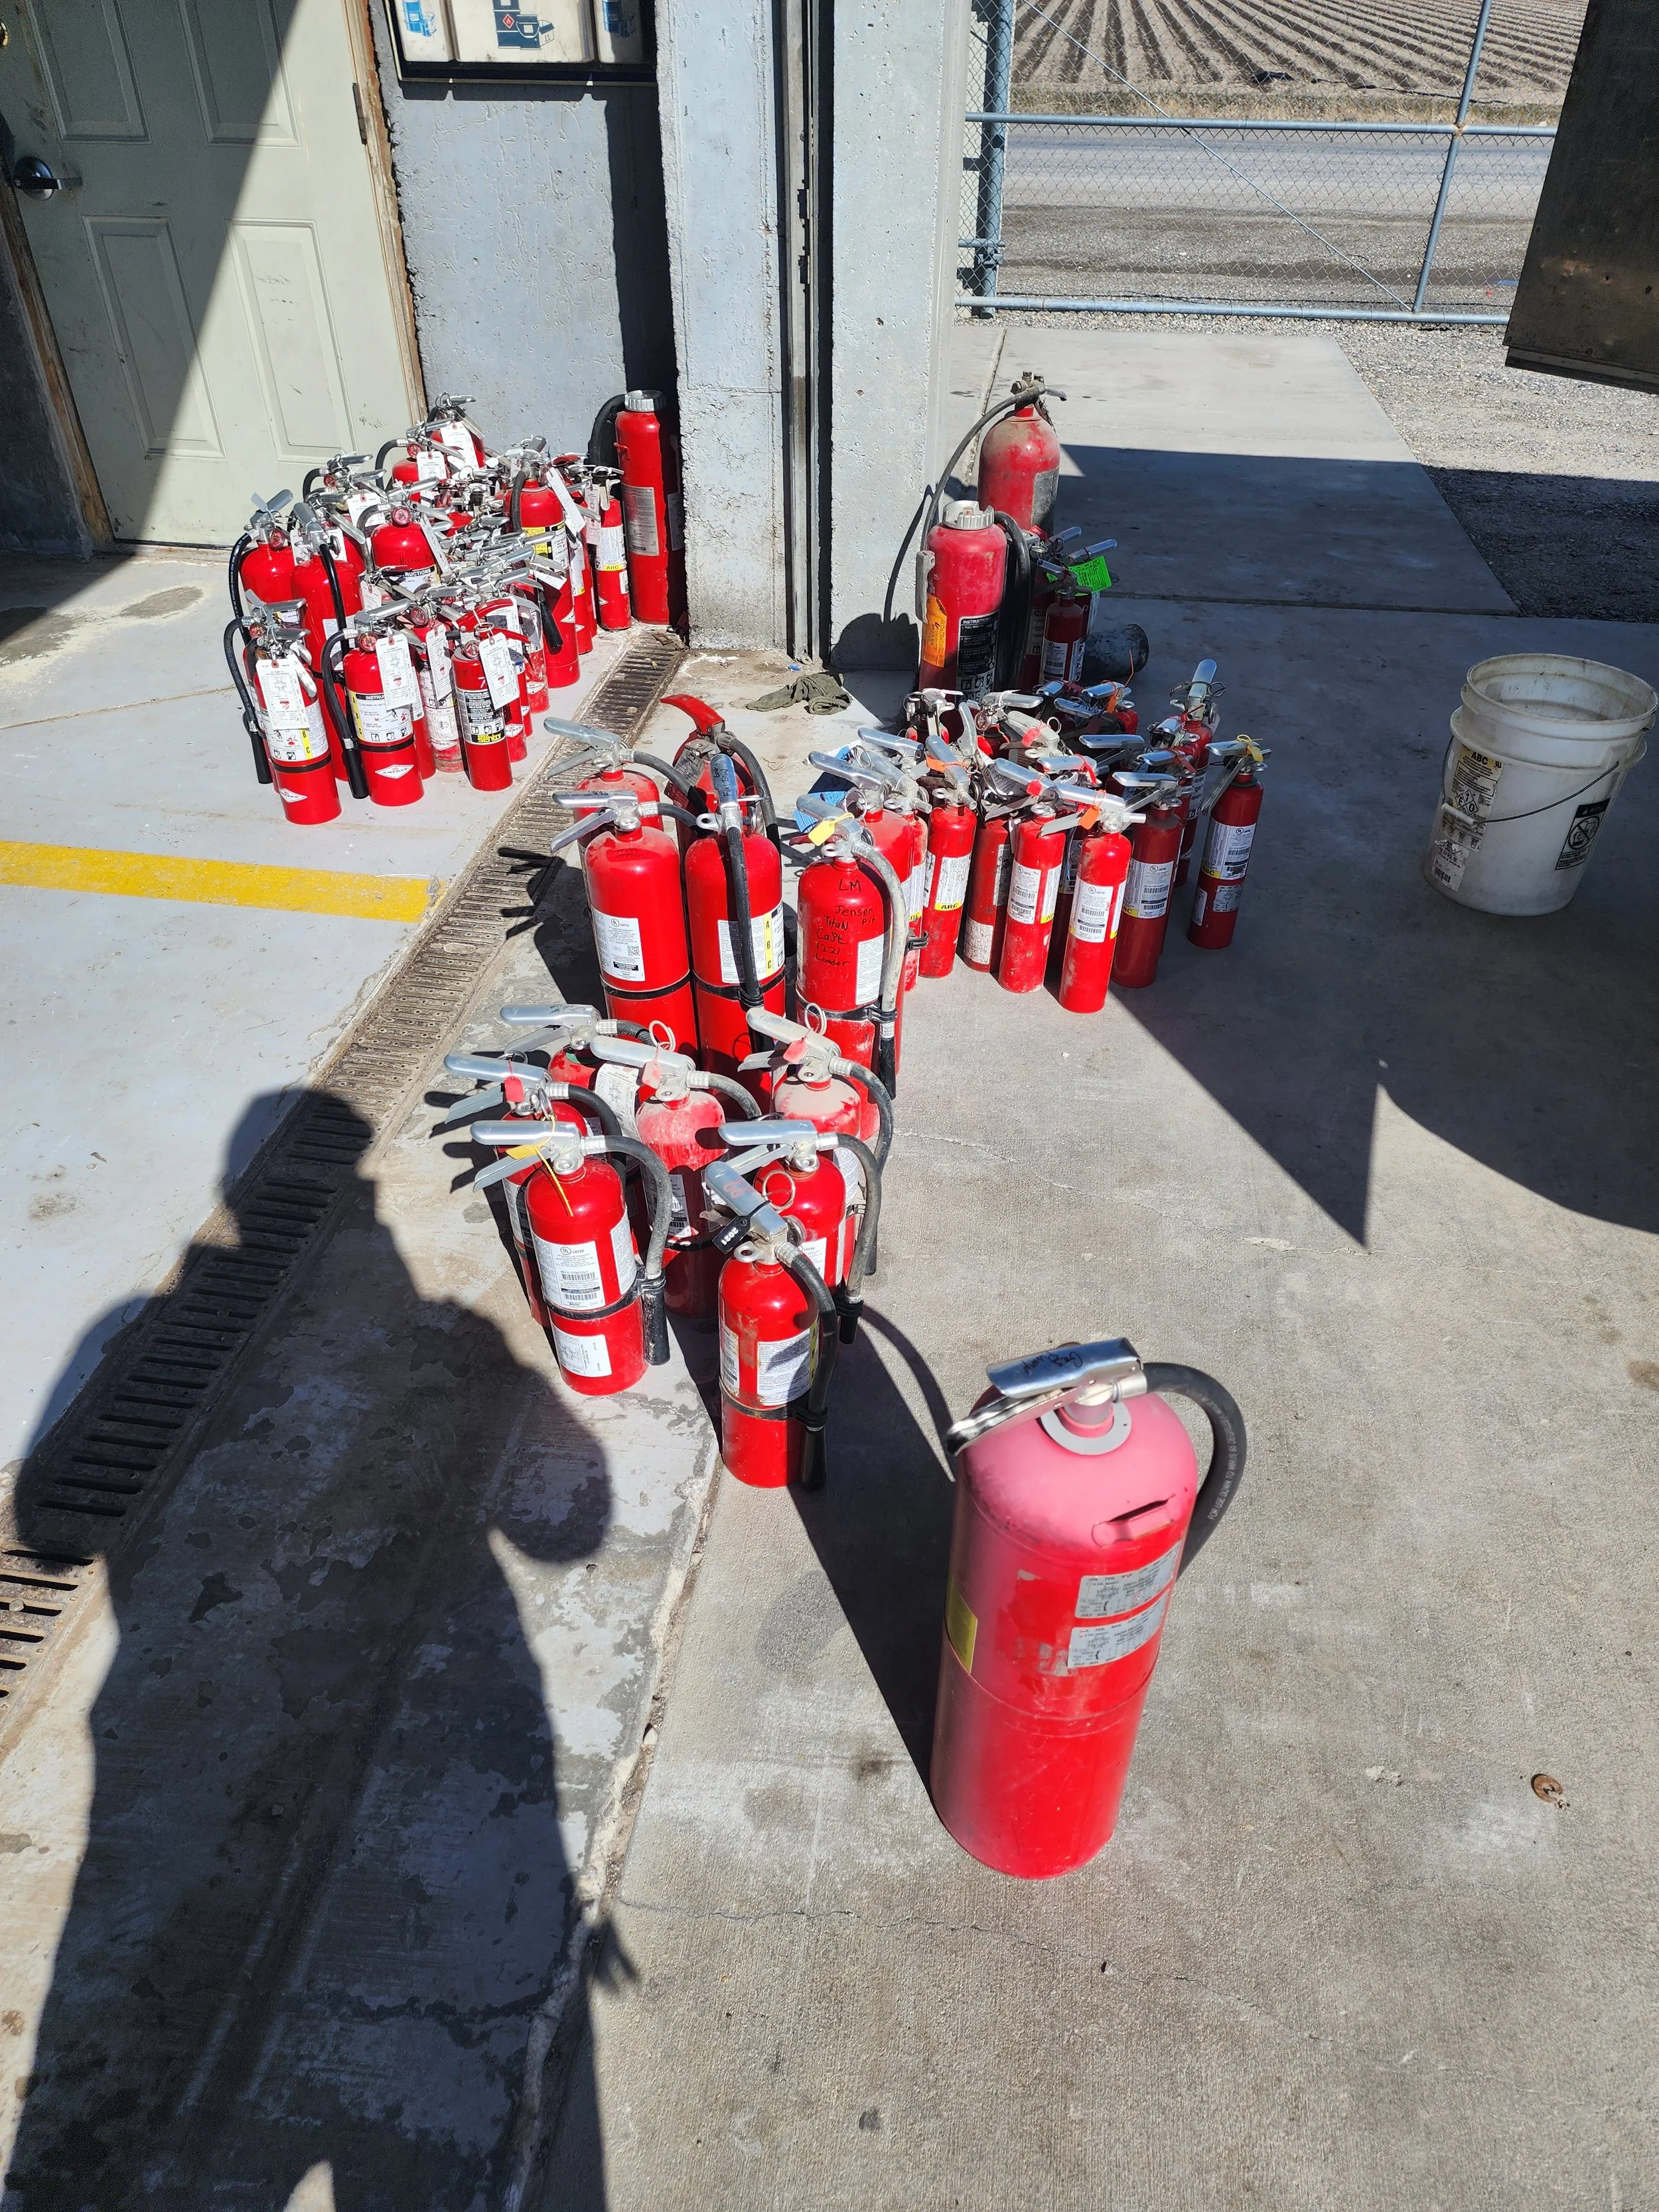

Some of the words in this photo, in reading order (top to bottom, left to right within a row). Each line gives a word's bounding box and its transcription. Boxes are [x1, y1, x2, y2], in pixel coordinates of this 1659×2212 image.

[402, 568, 431, 577] RUCTIONS
[302, 730, 307, 739] B
[305, 746, 311, 755] C
[1471, 751, 1488, 765] ABC
[839, 878, 862, 893] LM
[835, 905, 873, 917] Jensen
[766, 920, 770, 929] A
[766, 940, 770, 949] B
[815, 942, 841, 956] 1221
[768, 960, 772, 969] C
[720, 1227, 739, 1246] 2021
[1228, 1453, 1237, 1470] MINUS
[1219, 1479, 1232, 1497] DOWN
[1214, 1497, 1226, 1509] USE
[1208, 1507, 1220, 1520] FOR
